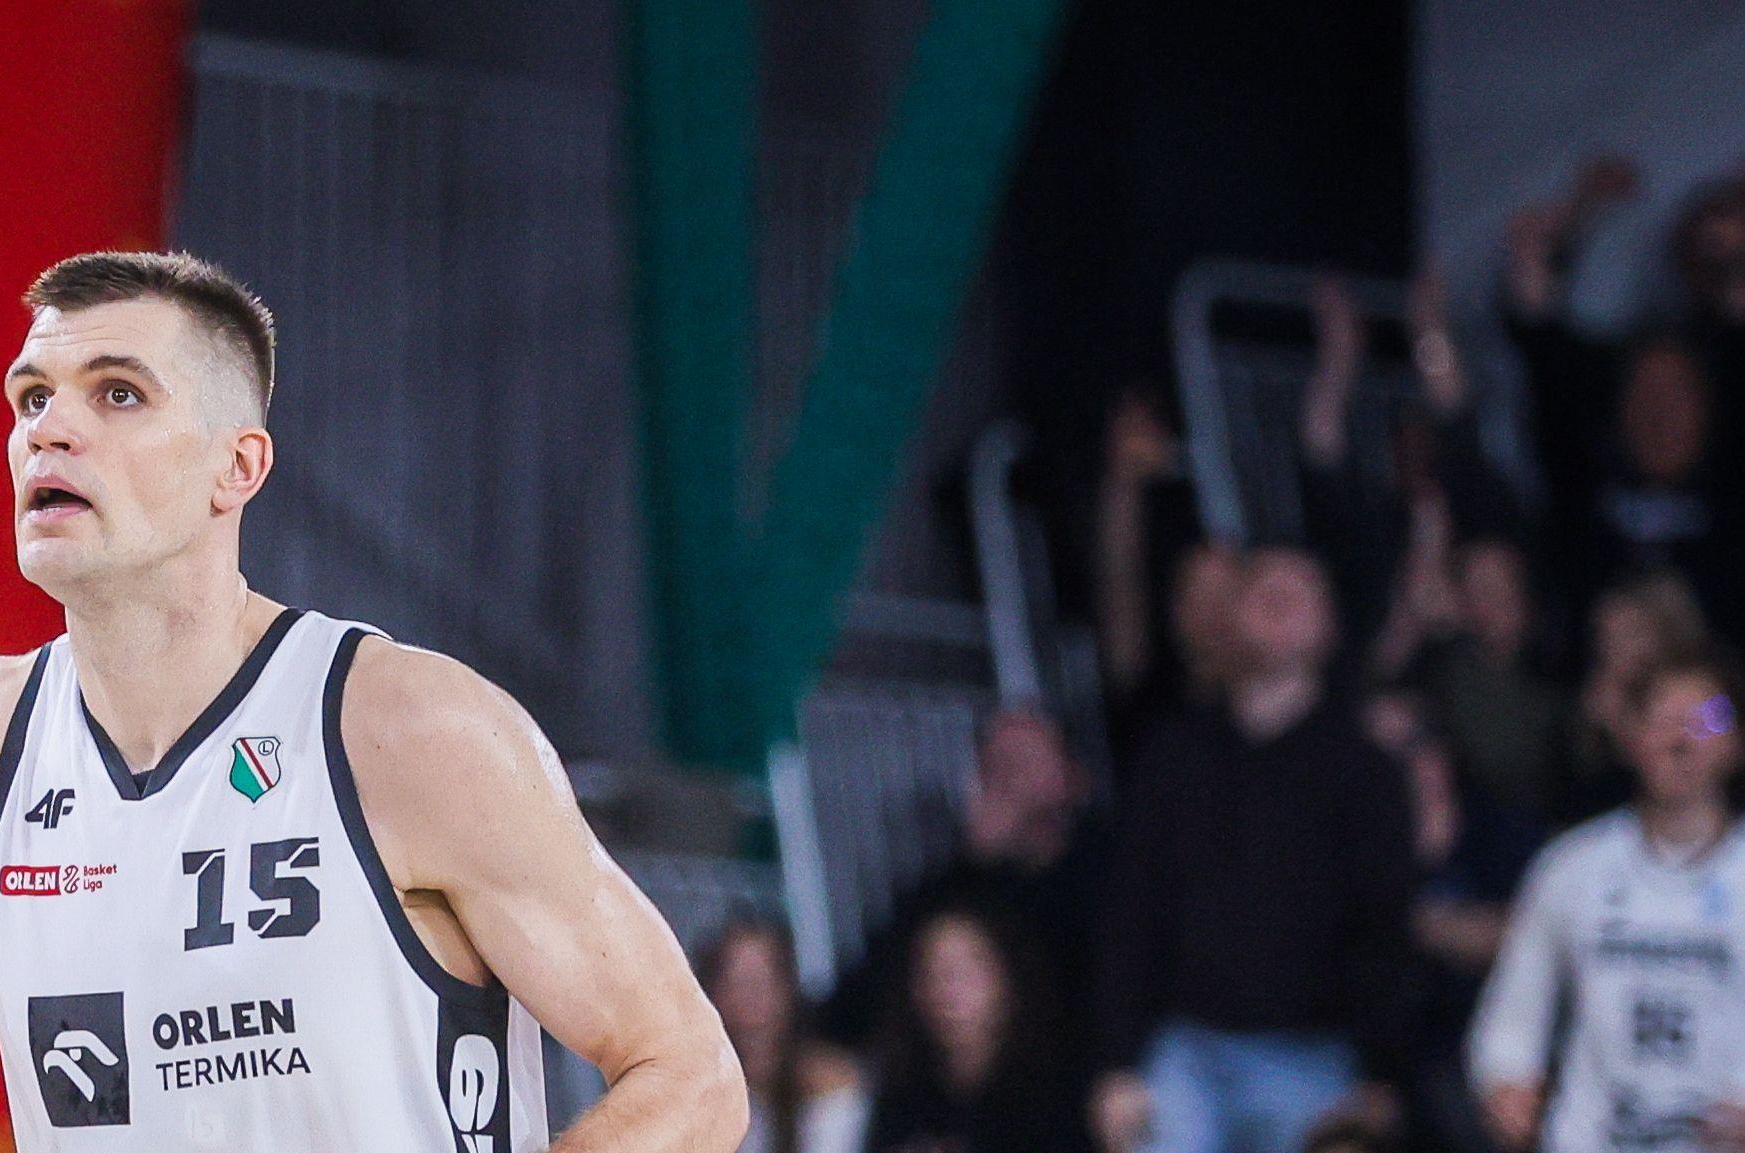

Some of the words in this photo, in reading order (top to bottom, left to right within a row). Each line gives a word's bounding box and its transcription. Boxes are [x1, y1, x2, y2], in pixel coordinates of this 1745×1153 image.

[25, 788, 76, 830] 4F
[83, 863, 118, 877] Basket
[83, 879, 103, 893] Liga
[181, 836, 321, 953] 15
[152, 998, 296, 1050] ORLEN
[155, 1047, 312, 1091] TERMIKA
